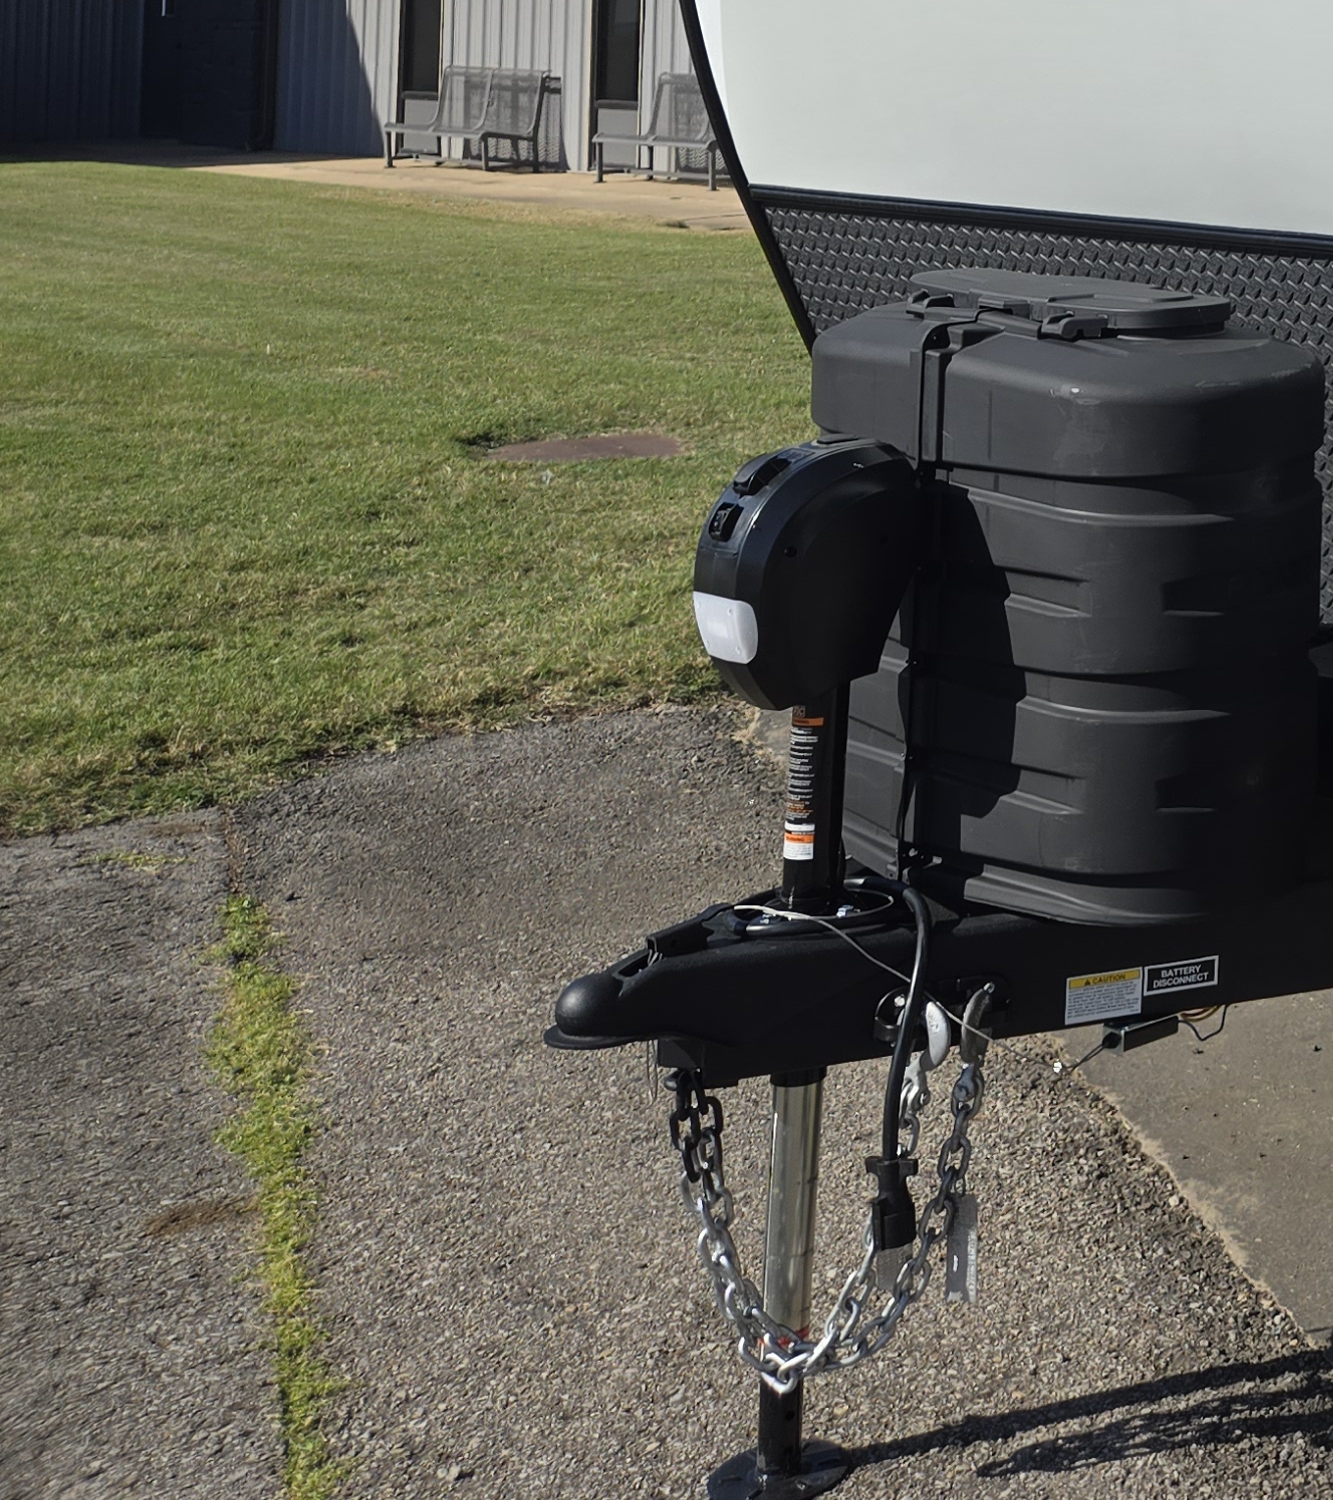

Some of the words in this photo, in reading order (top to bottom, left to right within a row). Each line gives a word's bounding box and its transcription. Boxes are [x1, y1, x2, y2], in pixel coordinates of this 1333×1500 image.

[1161, 964, 1202, 978] BATTERY
[1092, 973, 1126, 984] CAUTION
[1153, 972, 1209, 988] DISCONNECT
